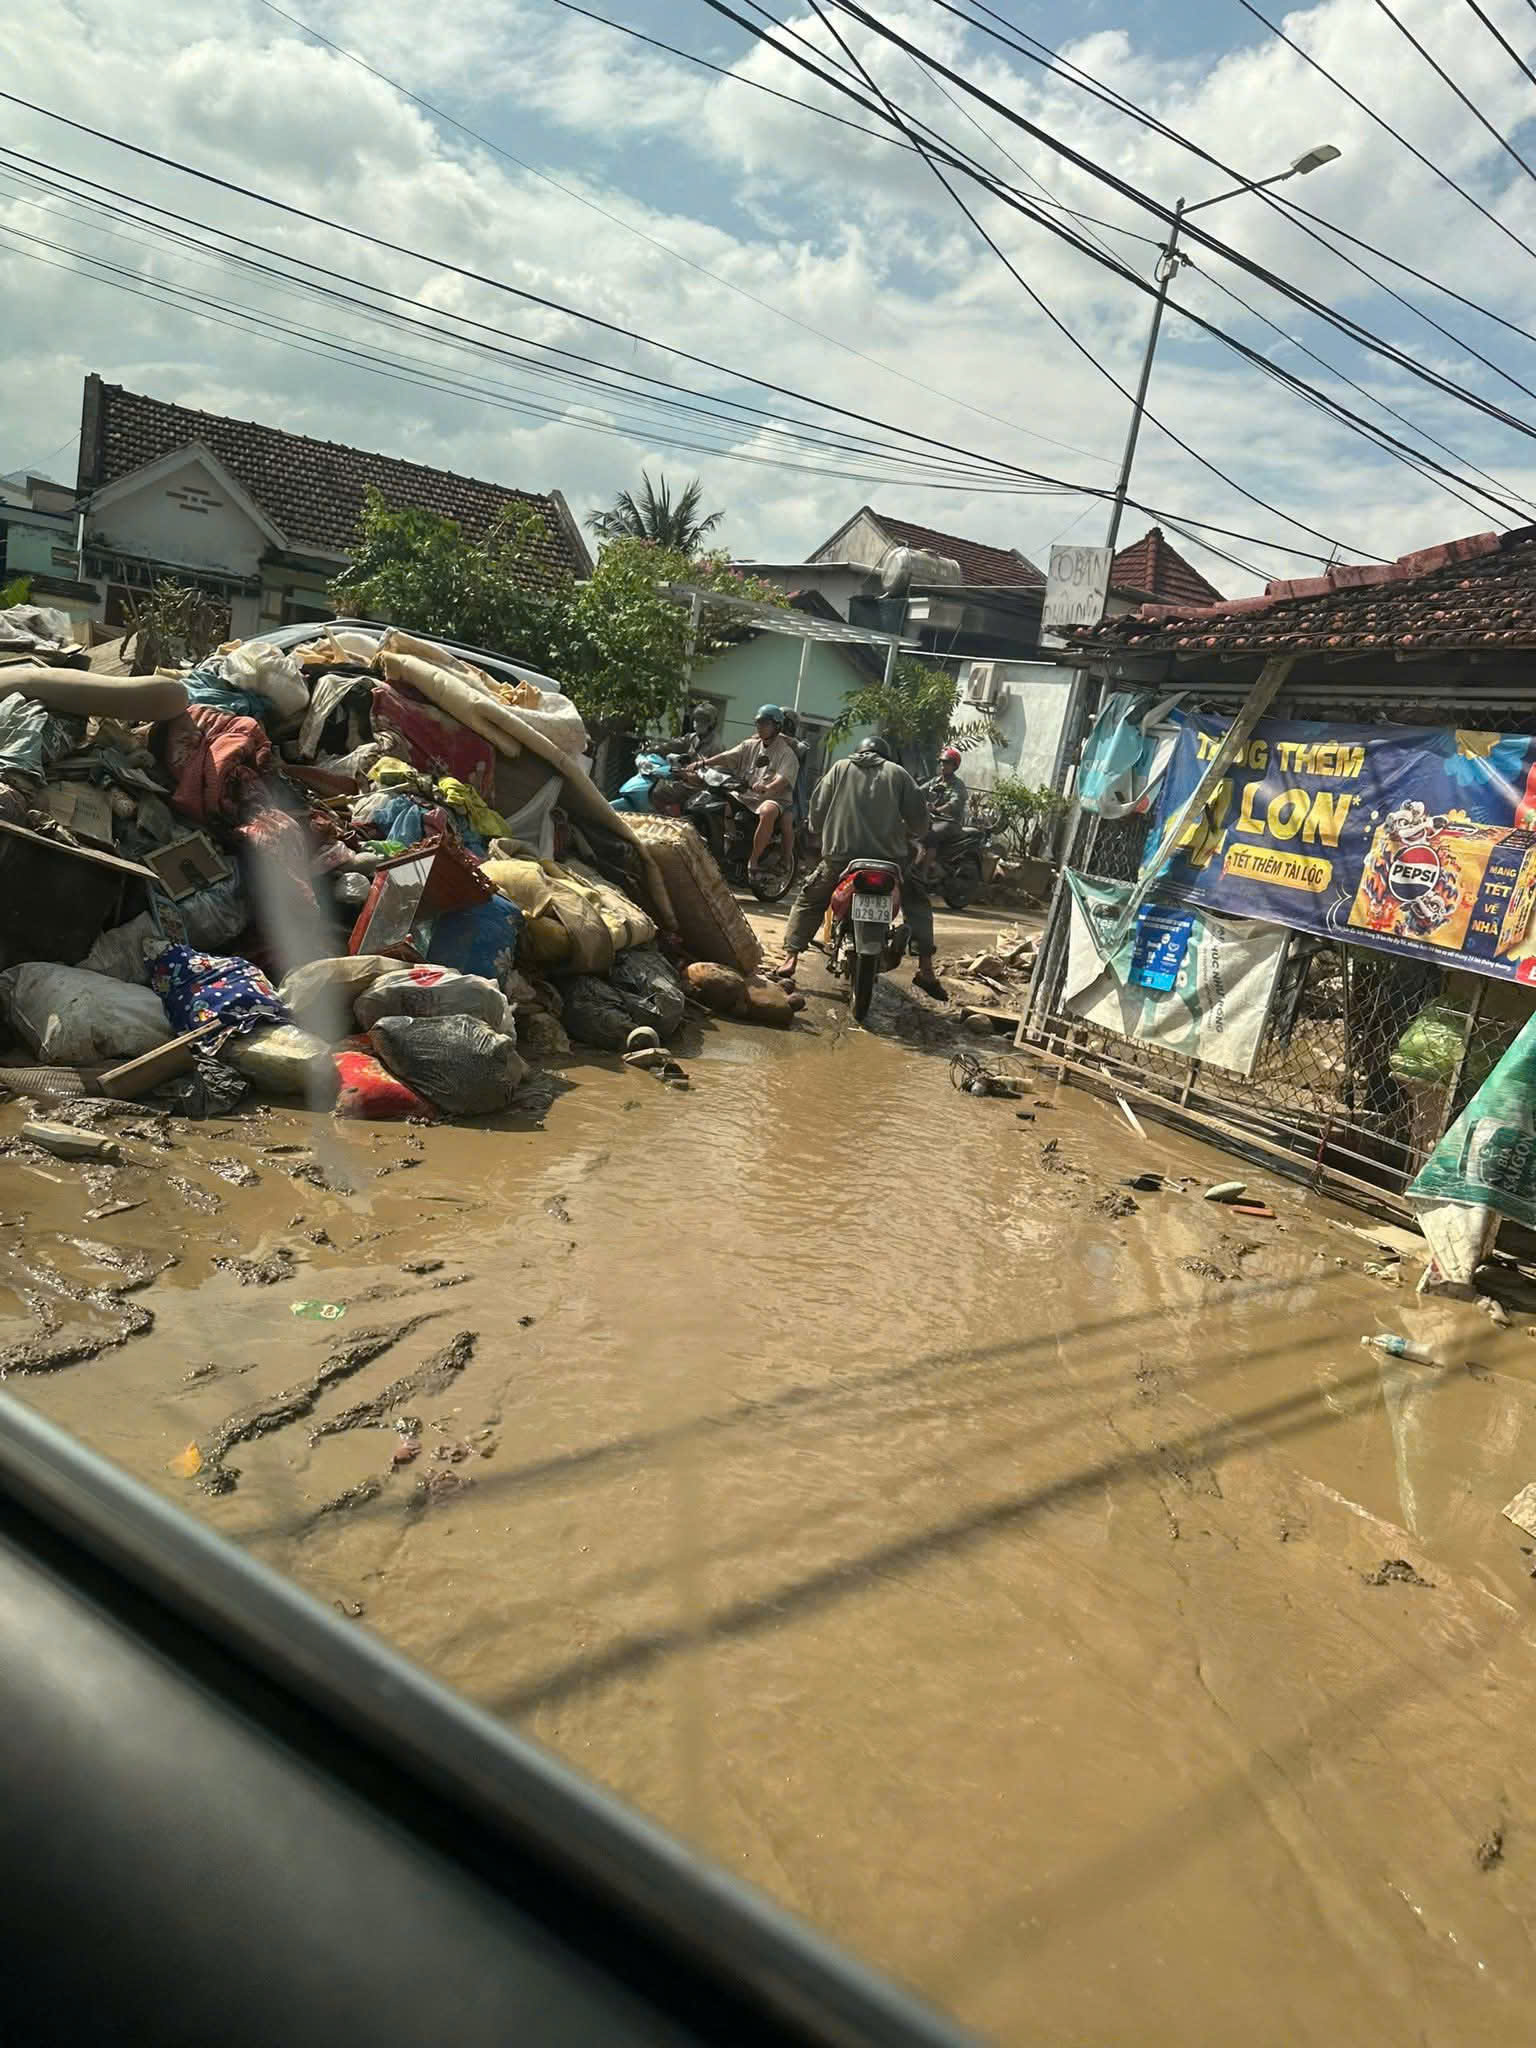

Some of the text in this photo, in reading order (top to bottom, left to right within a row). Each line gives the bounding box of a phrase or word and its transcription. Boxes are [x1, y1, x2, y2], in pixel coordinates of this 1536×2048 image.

[1277, 739, 1366, 778] THÊM
[1232, 849, 1324, 886] TẾT THÊM TÀI LỘC
[1392, 864, 1436, 883] PEPSI
[1489, 866, 1517, 879] MANG
